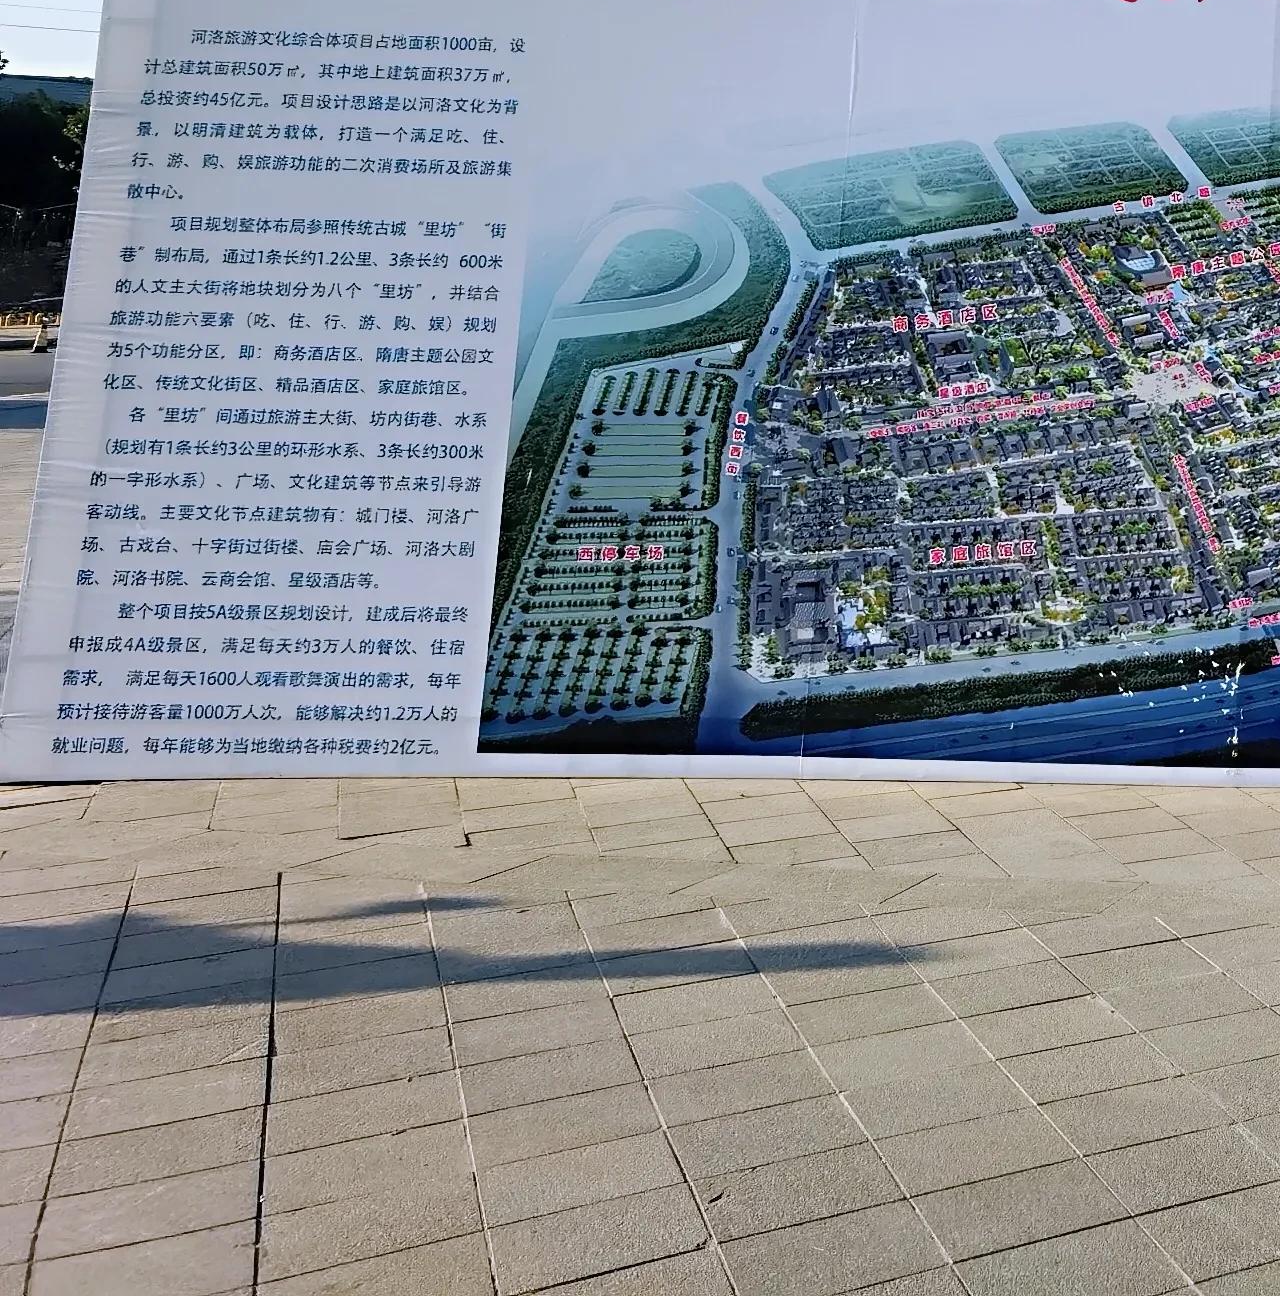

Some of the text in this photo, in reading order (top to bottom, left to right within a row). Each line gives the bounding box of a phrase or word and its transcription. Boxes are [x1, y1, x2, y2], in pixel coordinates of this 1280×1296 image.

[891, 303, 999, 333] 商务酒店区
[576, 545, 665, 562] 西停车场
[929, 540, 1038, 565] 家庭旅馆区
